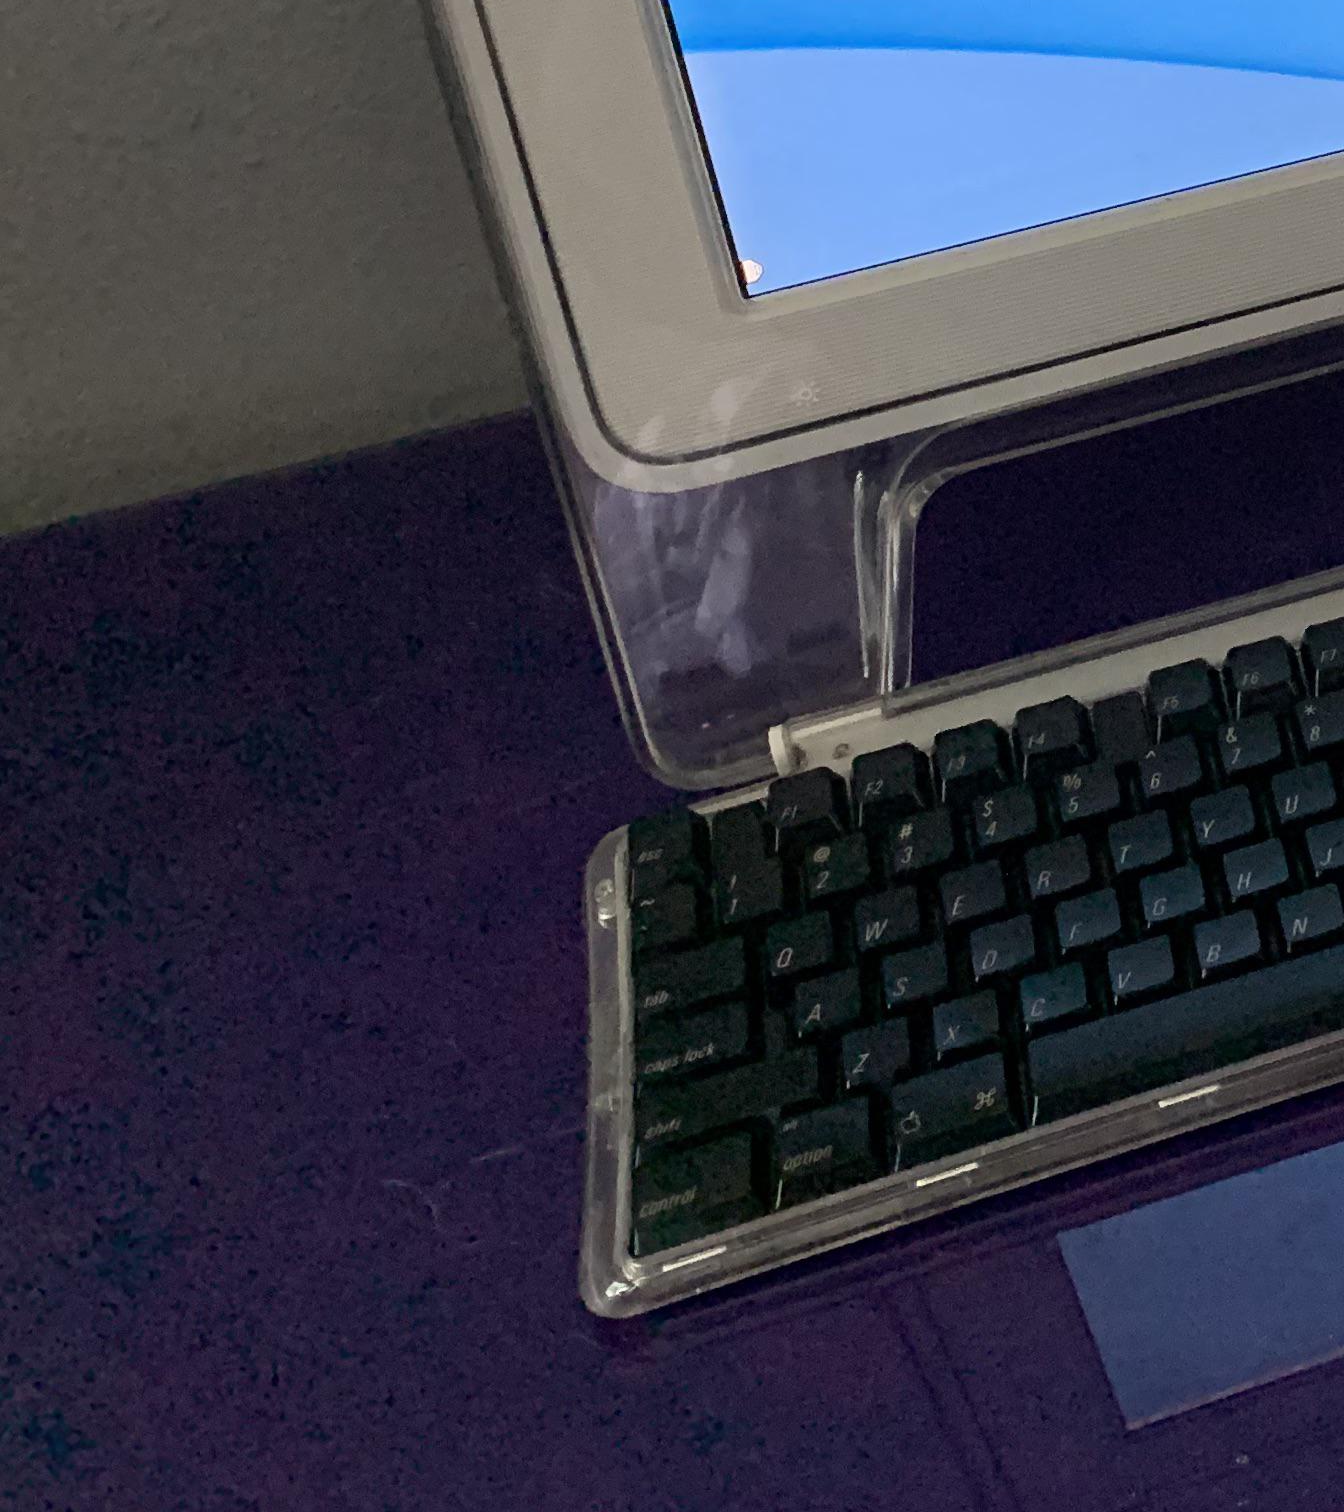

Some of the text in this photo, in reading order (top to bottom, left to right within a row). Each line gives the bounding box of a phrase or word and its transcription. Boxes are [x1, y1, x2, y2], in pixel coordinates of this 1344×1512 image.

[1321, 649, 1337, 664] F7
[1309, 725, 1321, 742] 8
[864, 779, 884, 797] F2
[781, 805, 798, 822] F1
[1285, 794, 1299, 814] U
[1202, 819, 1216, 839] Y
[813, 846, 831, 863] @
[1237, 871, 1252, 890] H
[952, 895, 967, 916] E
[1152, 898, 1167, 916] G
[865, 918, 889, 942] W
[1292, 917, 1308, 937] N
[982, 950, 998, 971] D
[1206, 944, 1222, 963] B
[893, 976, 909, 997] S
[644, 990, 670, 1009] tab
[1031, 998, 1046, 1017] C
[805, 1003, 823, 1024] A
[644, 1043, 715, 1074] caps lock
[852, 1053, 870, 1074] Z
[644, 1119, 683, 1138] shift
[783, 1145, 834, 1172] option
[639, 1186, 698, 1219] control
